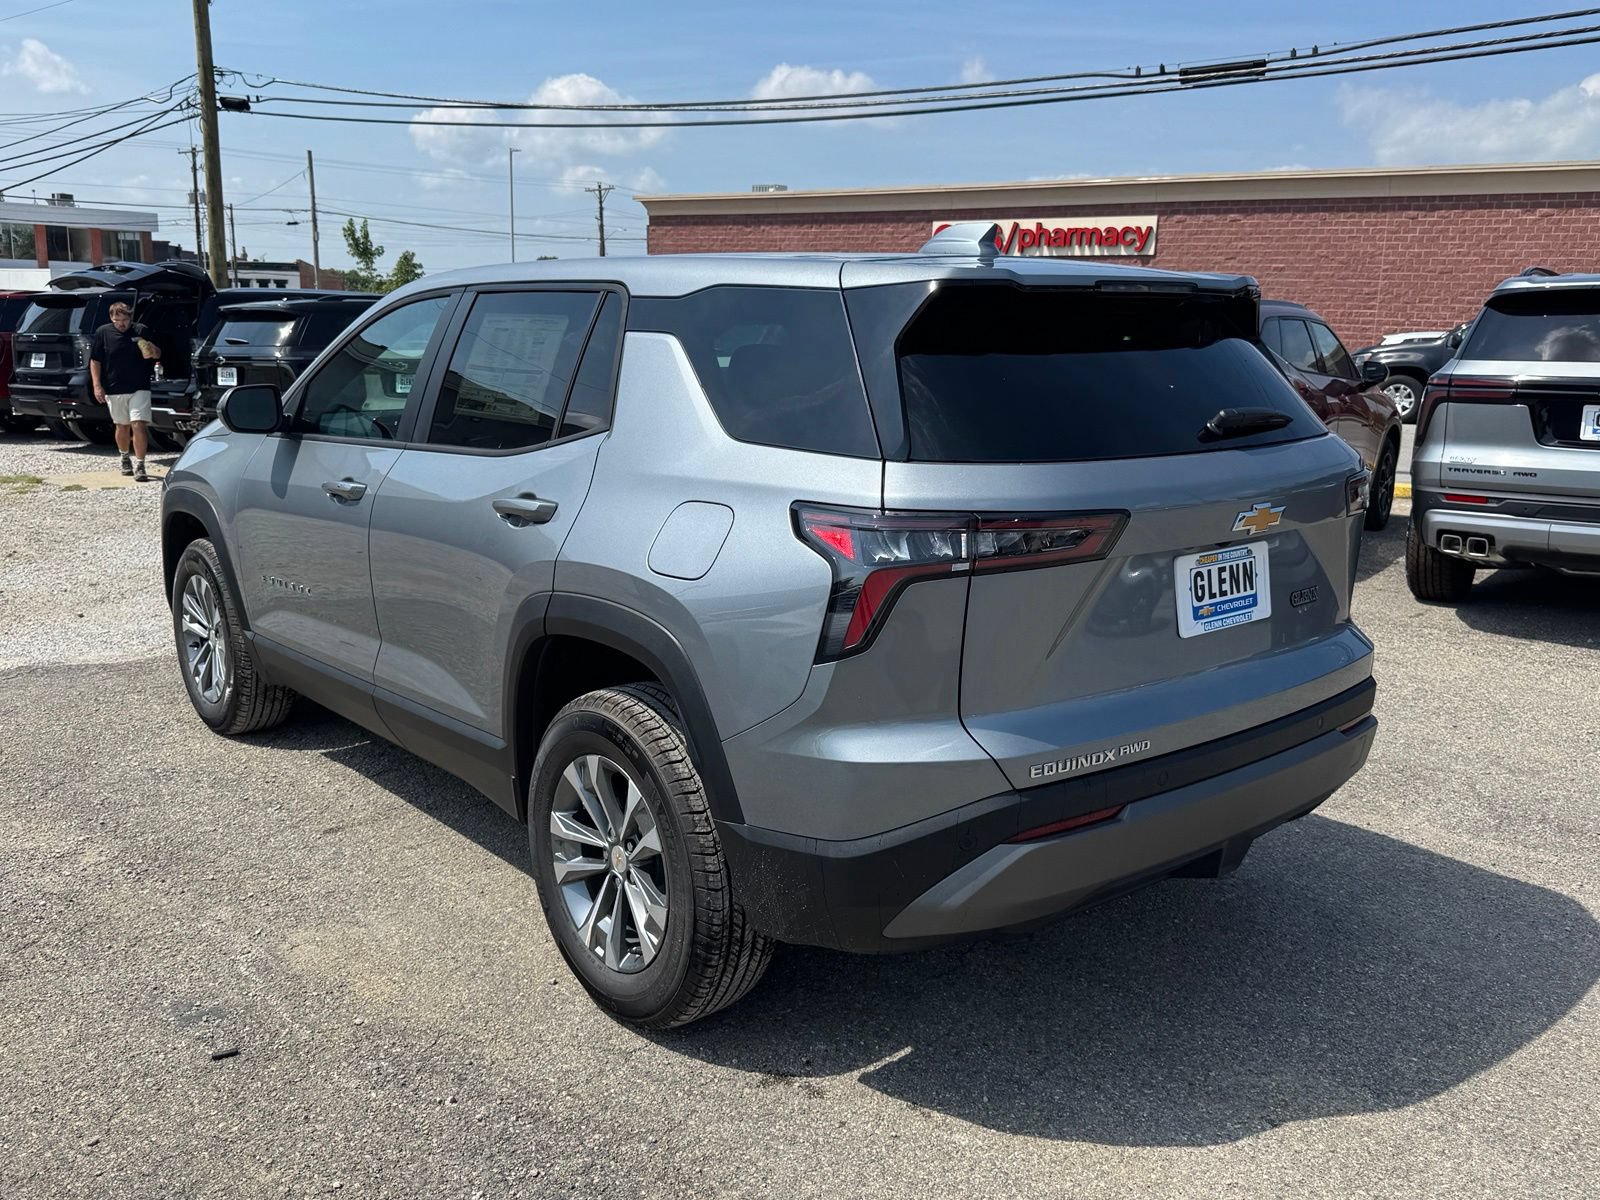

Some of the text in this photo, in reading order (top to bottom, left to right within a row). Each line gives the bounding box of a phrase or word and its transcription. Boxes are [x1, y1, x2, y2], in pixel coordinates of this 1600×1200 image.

[934, 222, 1153, 253] /pharmacy
[1193, 561, 1254, 603] GLENN
[1217, 598, 1254, 611] CHEVROLET
[1204, 612, 1252, 631] GLENN CHEVROLET
[1030, 740, 1151, 779] EQUINOX AWD
